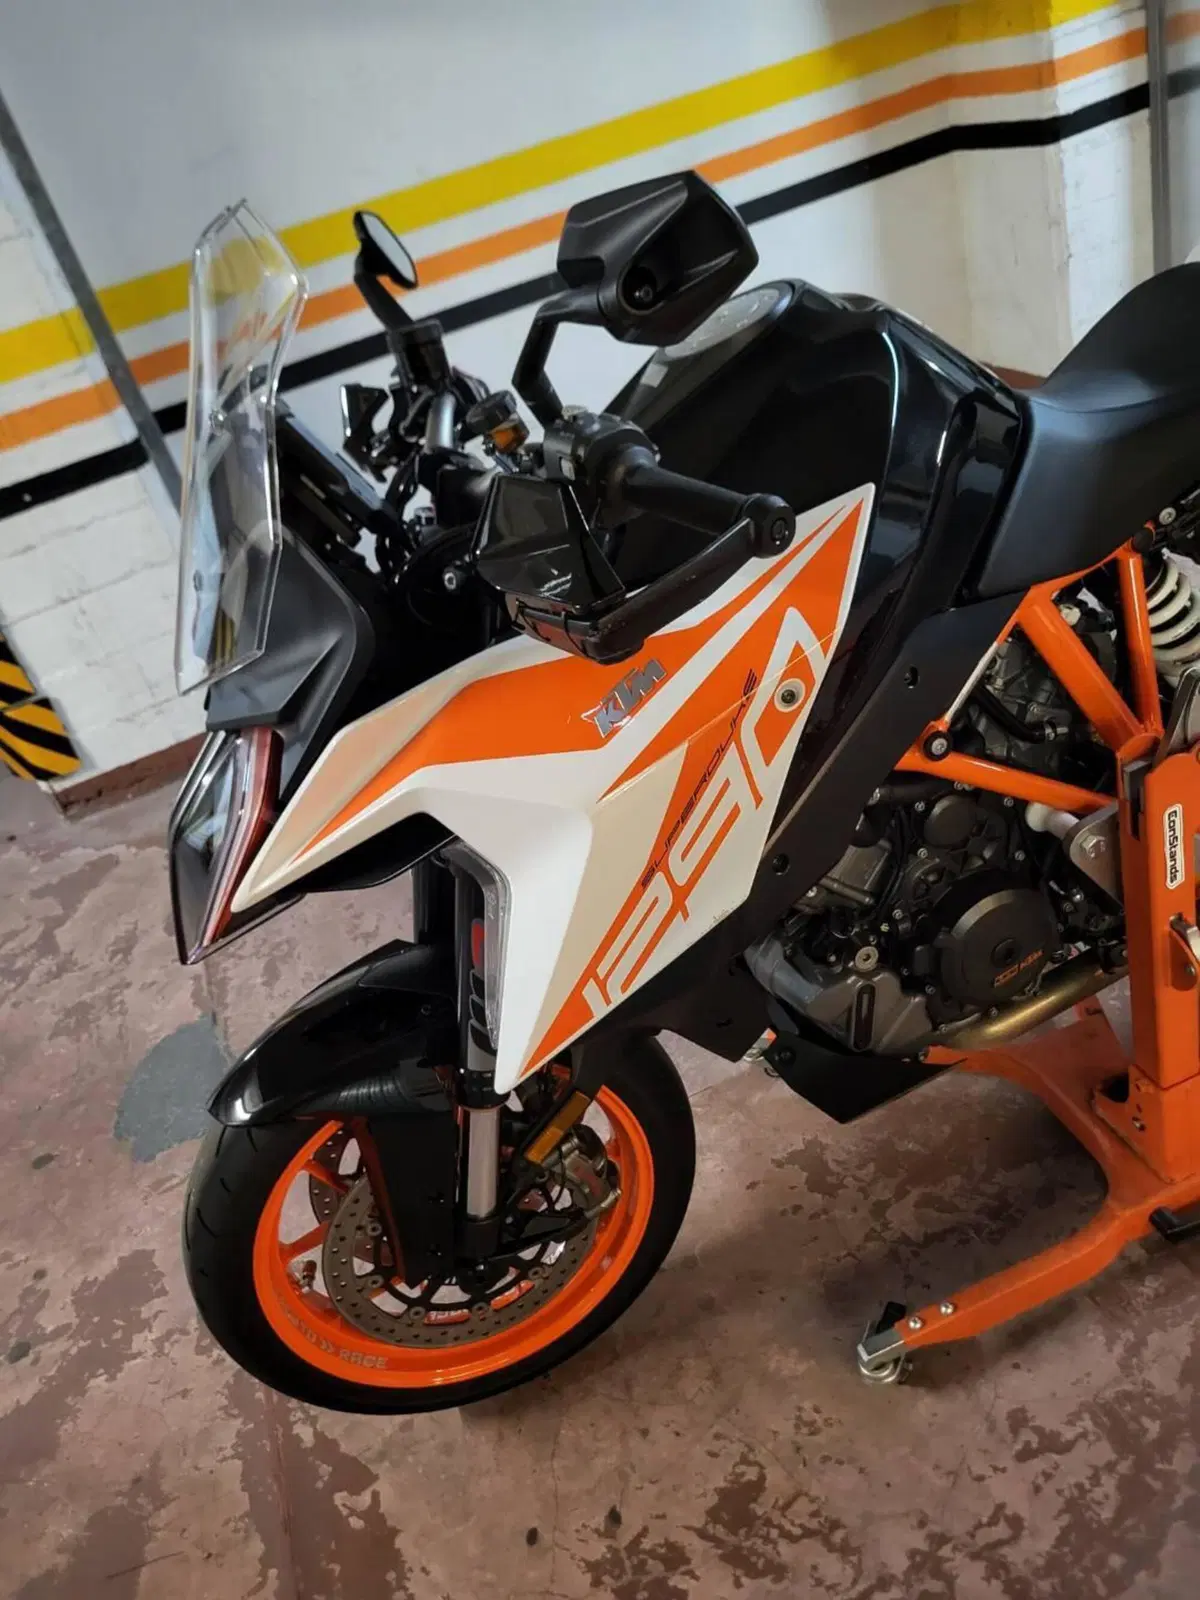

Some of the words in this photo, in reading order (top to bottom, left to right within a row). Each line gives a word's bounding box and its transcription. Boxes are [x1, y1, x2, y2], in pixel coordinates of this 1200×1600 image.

[581, 658, 667, 738] KTM
[581, 606, 828, 1018] 1290
[338, 1348, 389, 1369] RACE
